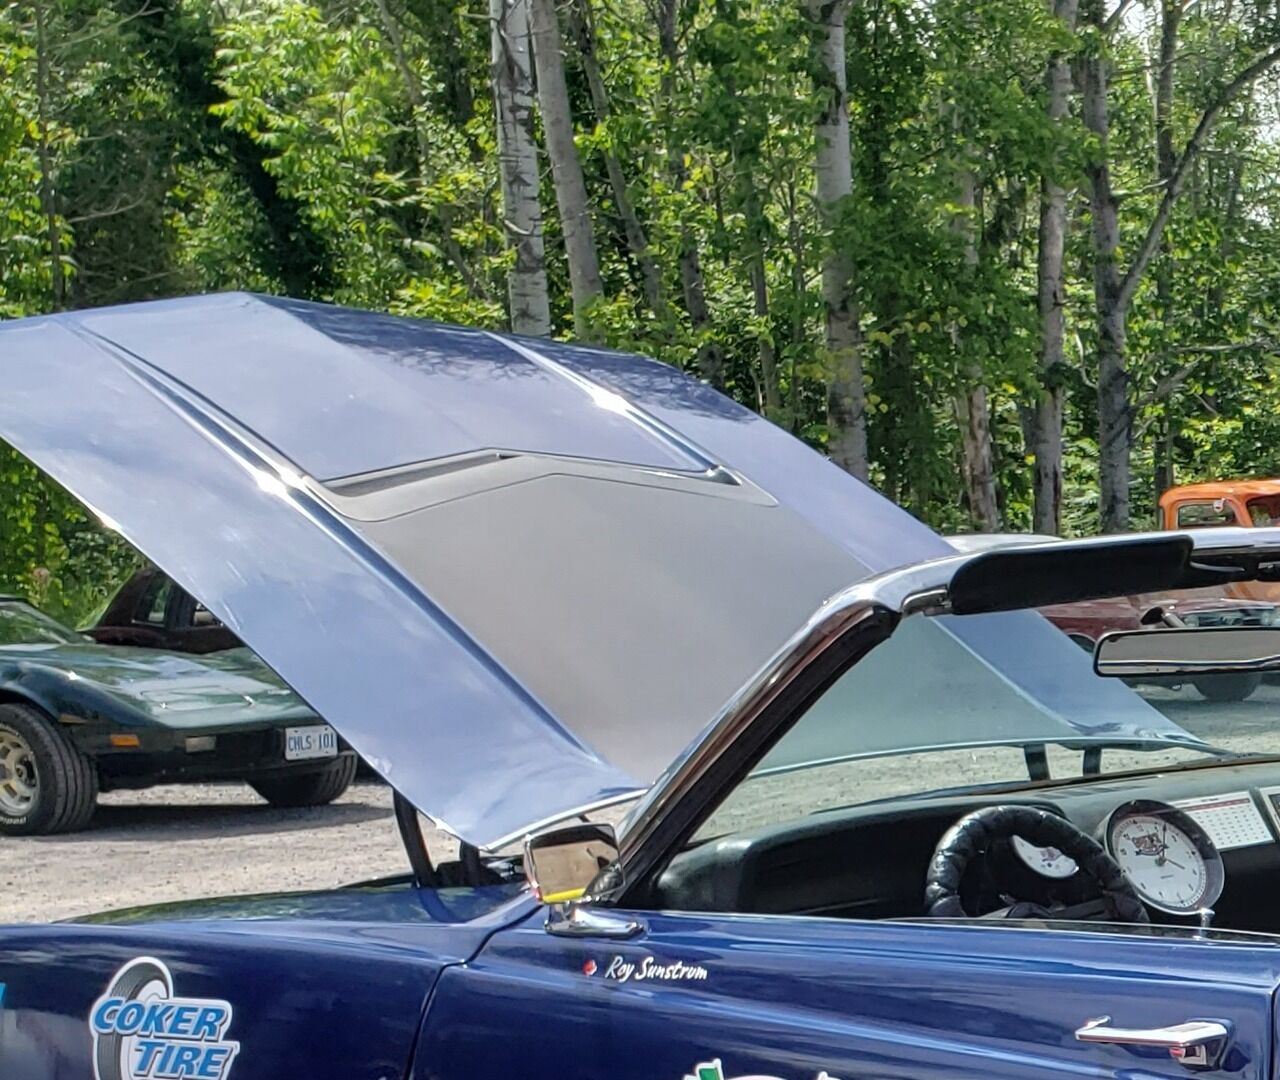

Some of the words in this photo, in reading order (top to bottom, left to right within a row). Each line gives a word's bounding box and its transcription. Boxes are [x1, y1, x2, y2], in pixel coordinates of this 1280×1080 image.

[605, 955, 635, 983] Roy
[635, 956, 708, 980] Sunstrum
[94, 999, 227, 1039] COKER
[136, 1041, 230, 1080] TIRE
